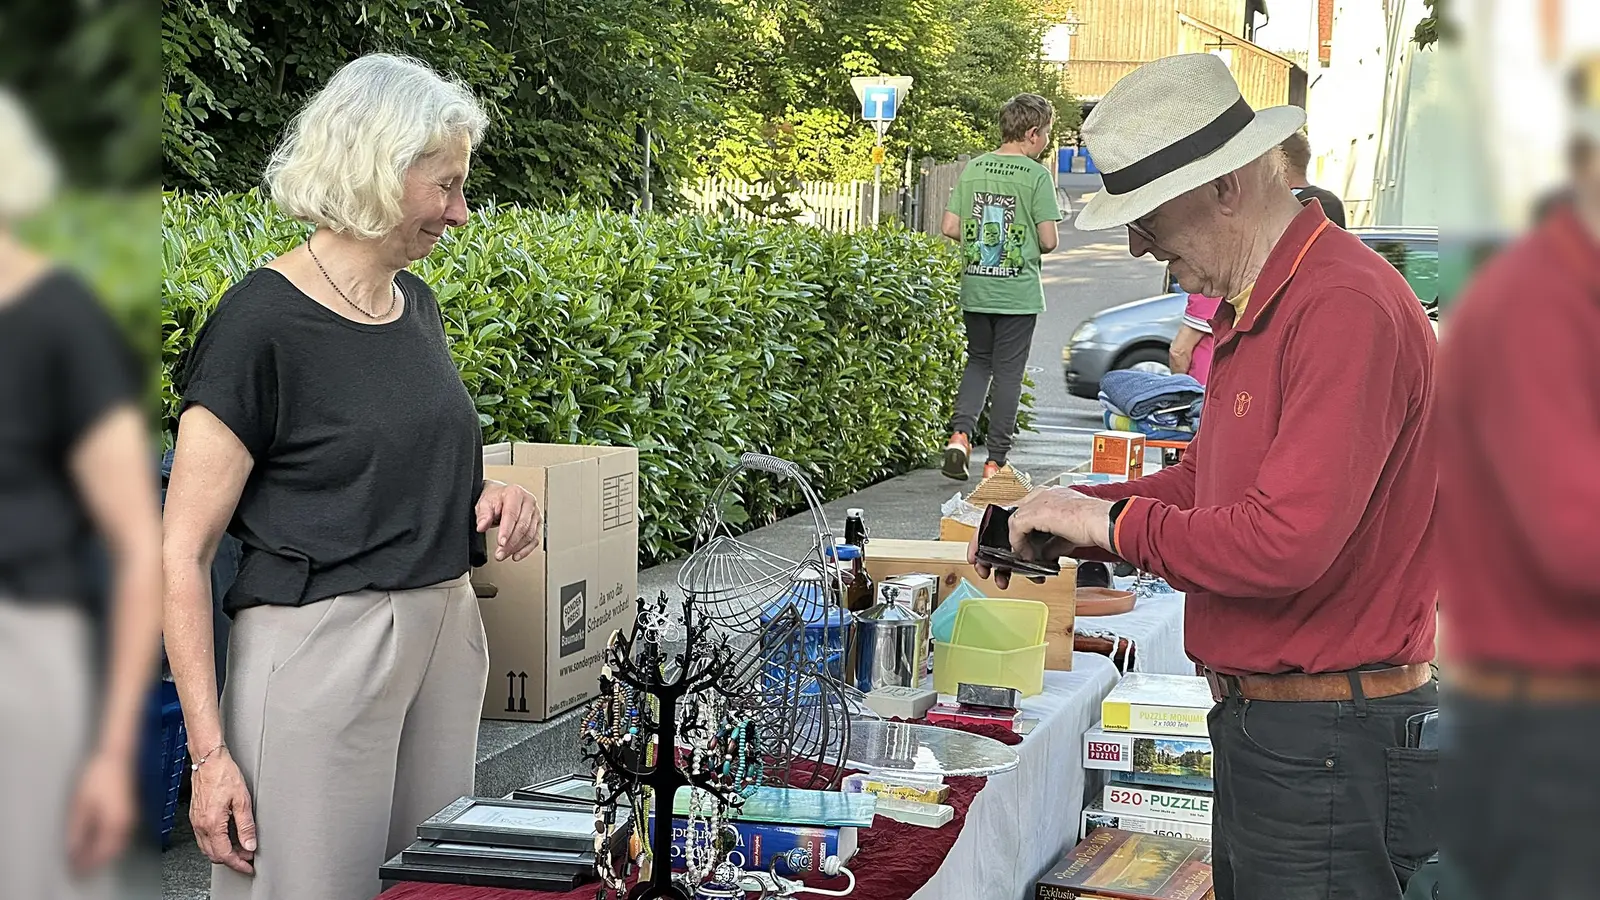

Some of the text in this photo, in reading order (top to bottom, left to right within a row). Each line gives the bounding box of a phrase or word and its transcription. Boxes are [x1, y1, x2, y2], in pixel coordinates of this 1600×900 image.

[985, 167, 1015, 176] PROBLEM
[1005, 163, 1031, 174] ZOMBIE
[965, 263, 1020, 277] MINECRAFT
[561, 629, 585, 647] Baumarkt
[1140, 711, 1168, 721] PUZZLE
[1089, 743, 1120, 753] 1500
[1091, 751, 1118, 760] PUZZLE
[1110, 790, 1143, 806] 520
[1150, 794, 1209, 812] PUZZLE
